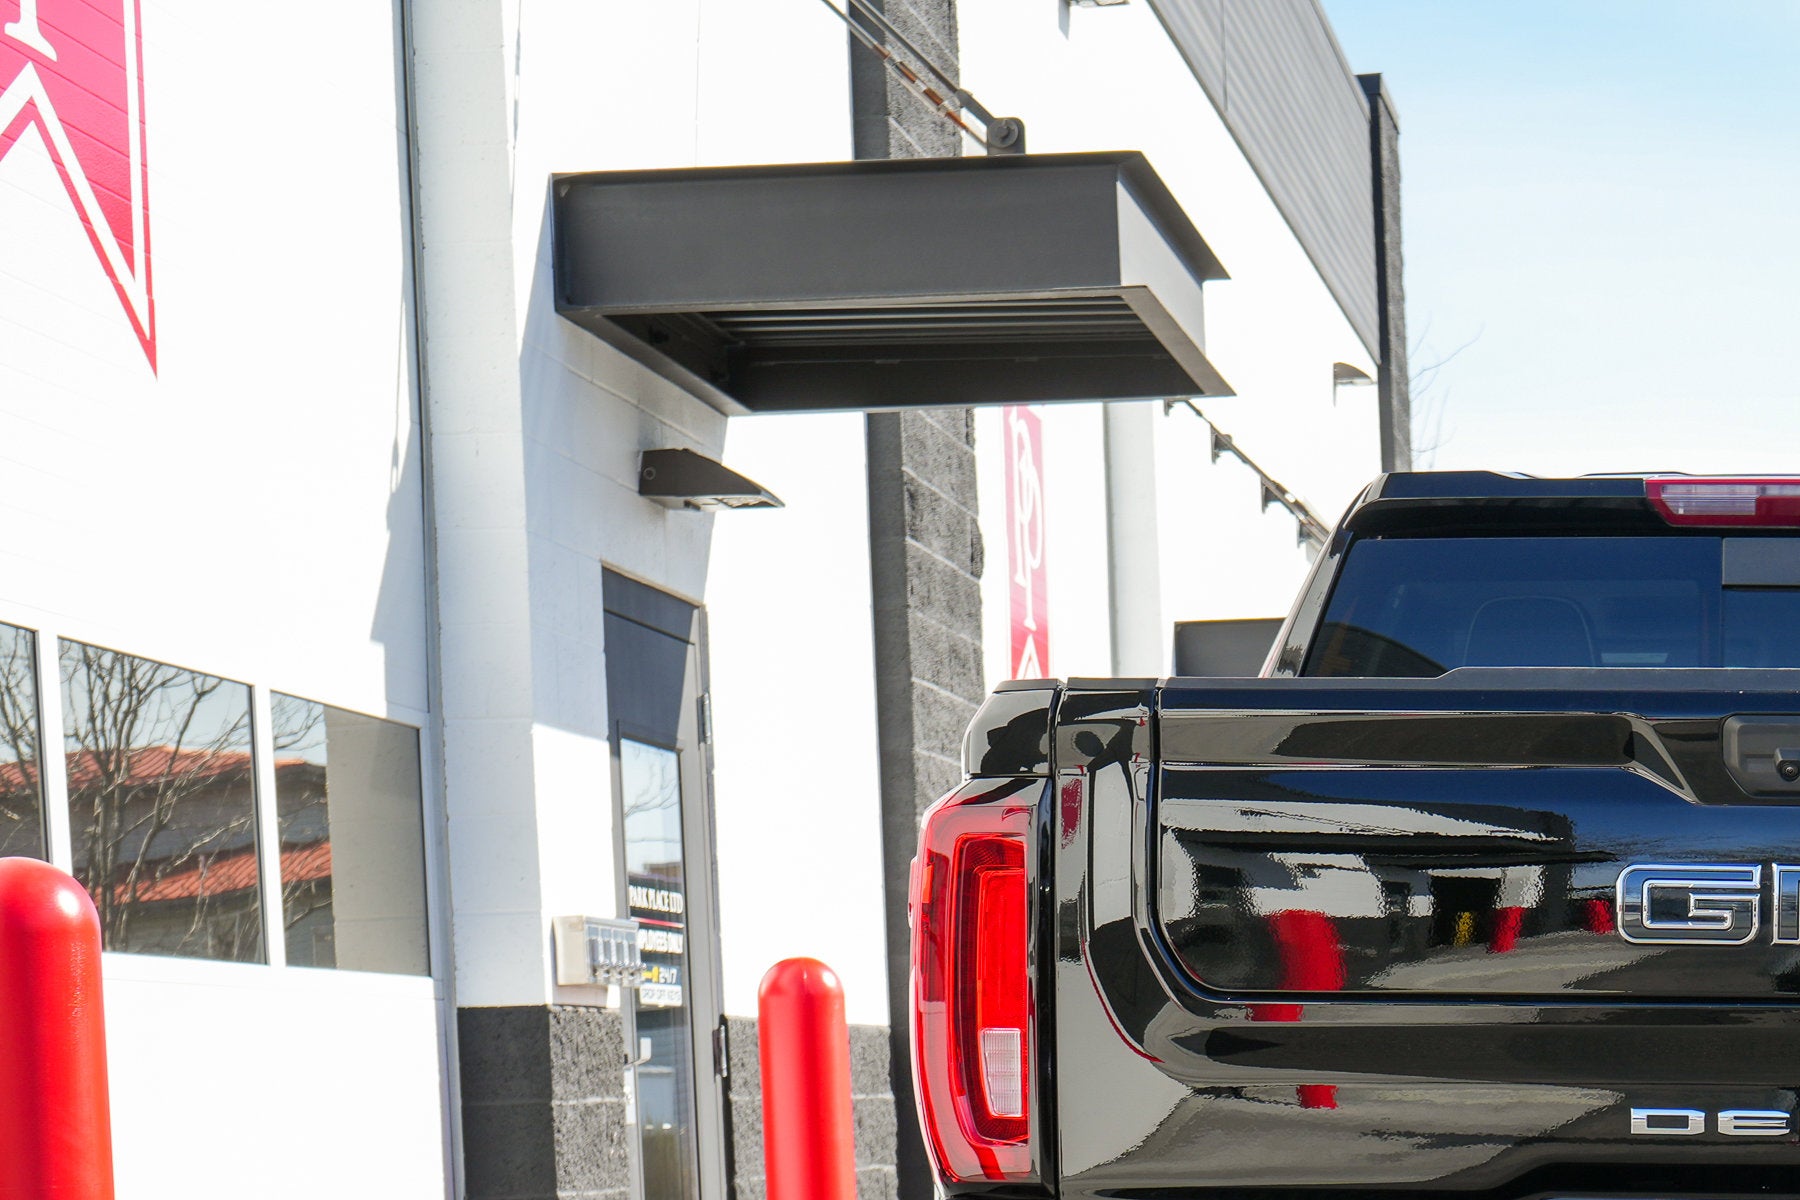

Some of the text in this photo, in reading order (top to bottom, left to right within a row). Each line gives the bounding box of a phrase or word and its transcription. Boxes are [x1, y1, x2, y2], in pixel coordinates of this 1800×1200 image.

[629, 885, 684, 914] PARK PLACE LTD
[659, 967, 677, 984] 24/7
